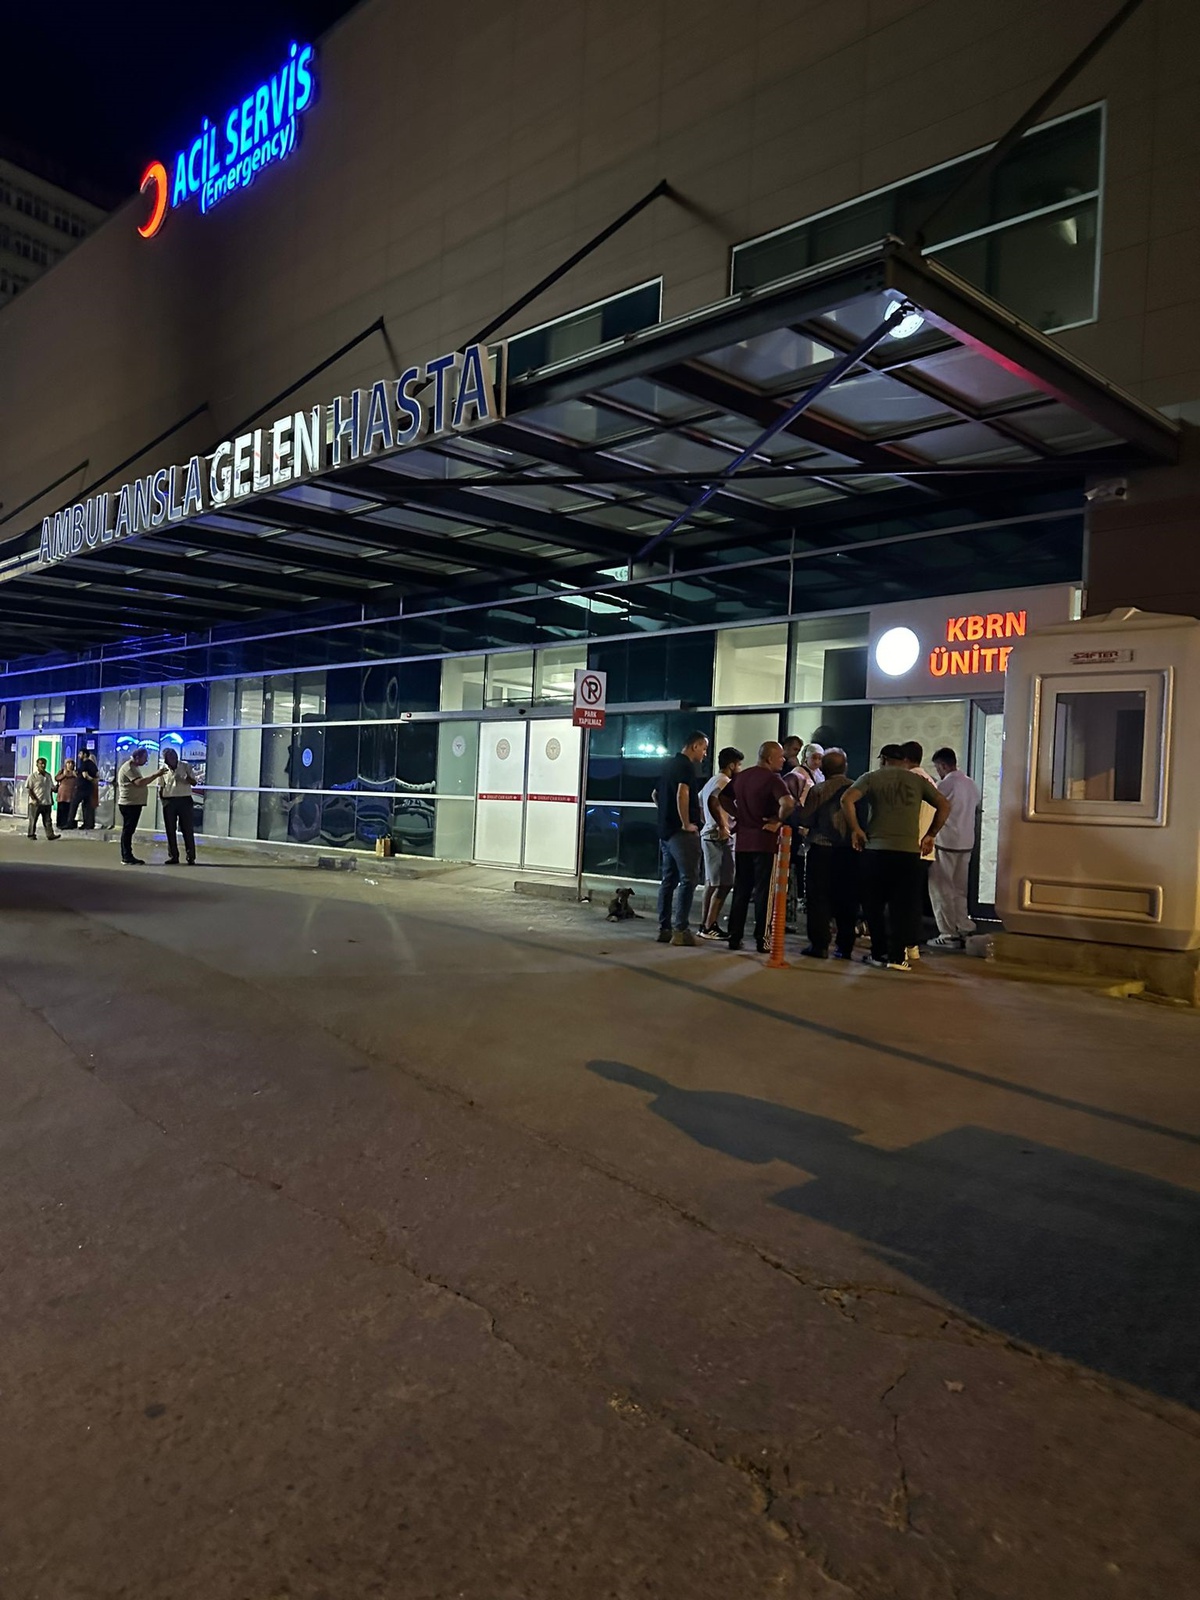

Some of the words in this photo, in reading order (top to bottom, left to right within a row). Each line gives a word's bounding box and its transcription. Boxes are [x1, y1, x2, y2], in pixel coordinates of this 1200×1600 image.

[171, 117, 221, 208] ACİL
[225, 42, 313, 166] SERVİS
[201, 114, 296, 214] (Emergency)
[38, 455, 204, 564] AMBULANSLA
[208, 405, 321, 504] GELEN
[332, 342, 490, 467] HASTA
[946, 610, 1027, 642] KBRN
[584, 710, 598, 718] PARK
[879, 781, 915, 806] NIKE
